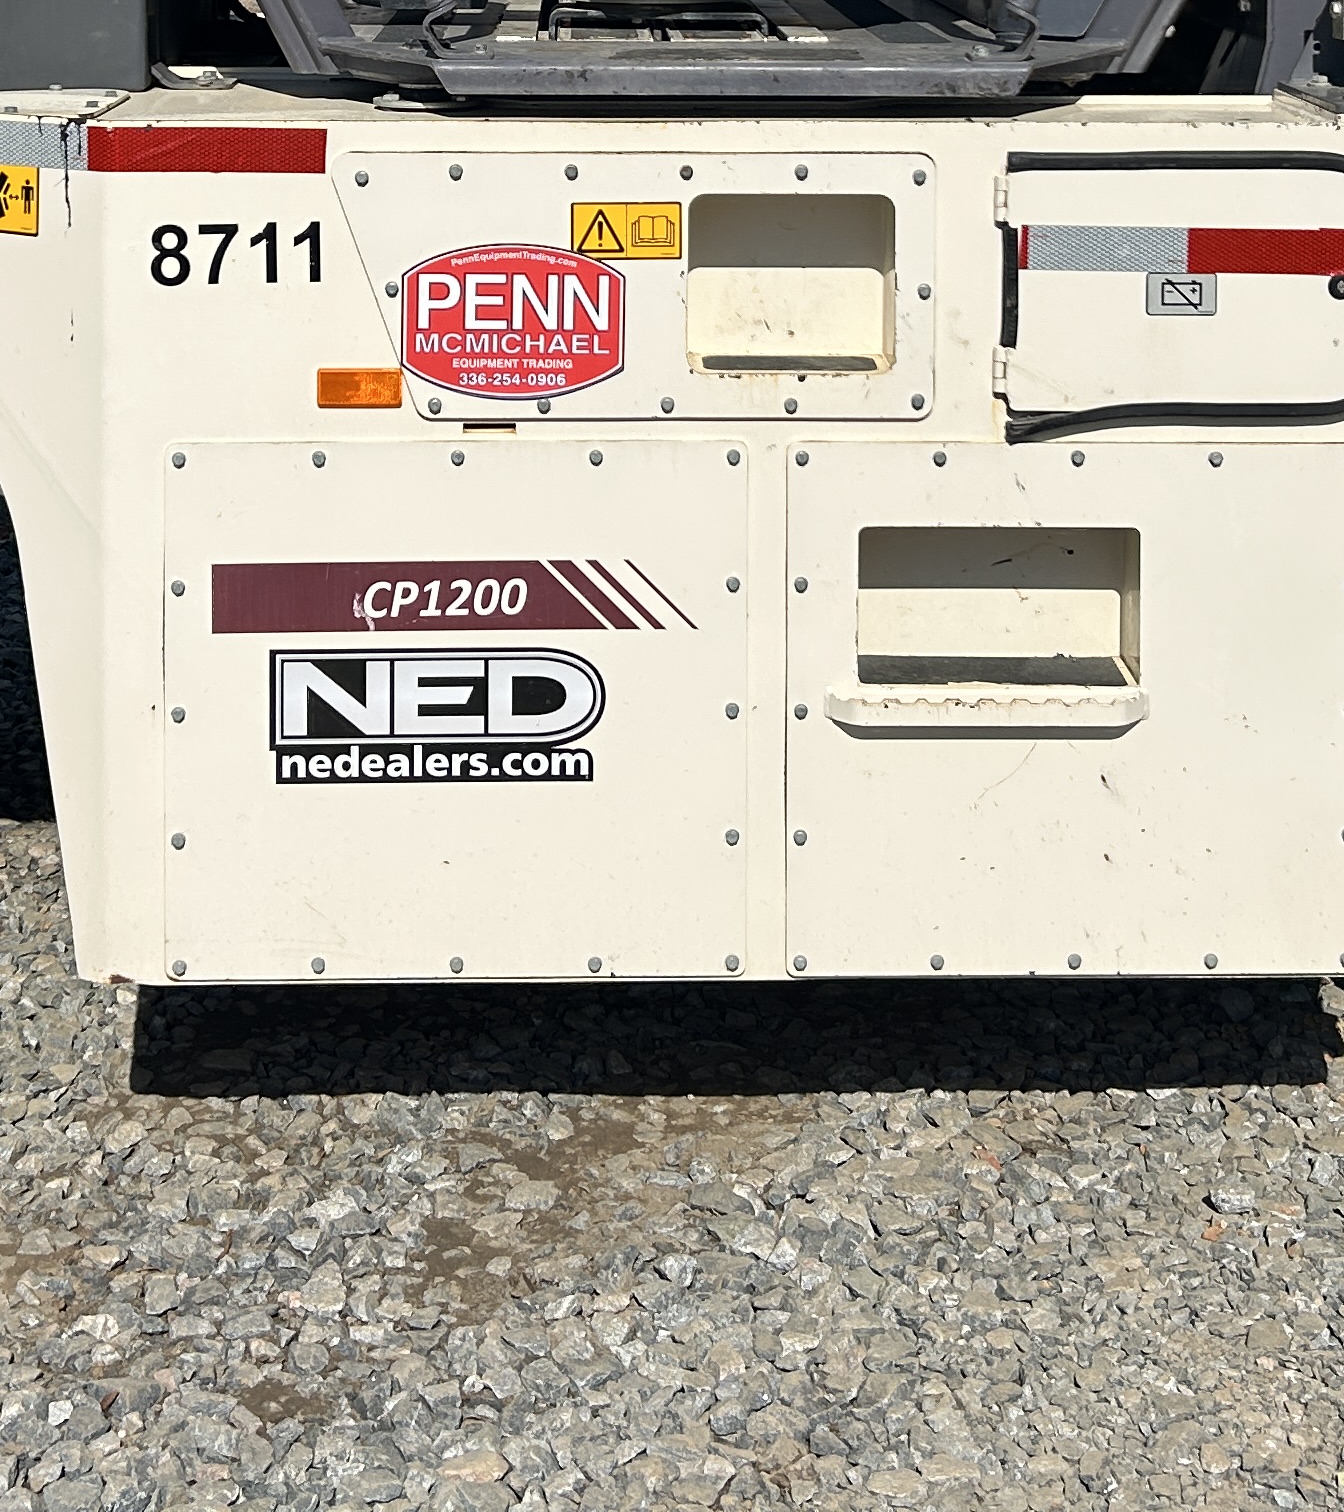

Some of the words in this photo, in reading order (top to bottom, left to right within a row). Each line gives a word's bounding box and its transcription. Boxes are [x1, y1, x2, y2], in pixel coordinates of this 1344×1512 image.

[150, 221, 321, 287] 8711
[450, 250, 578, 268] PennEquipmentTrading.com
[416, 272, 611, 331] PENN
[415, 333, 611, 355] MCMICHAEL
[452, 358, 519, 369] EQUIPMENT
[521, 358, 574, 370] TRADING
[458, 372, 567, 387] 336-254-0906
[363, 577, 528, 619] CP1200
[282, 658, 595, 737] NED
[280, 745, 590, 779] nedealers.com
